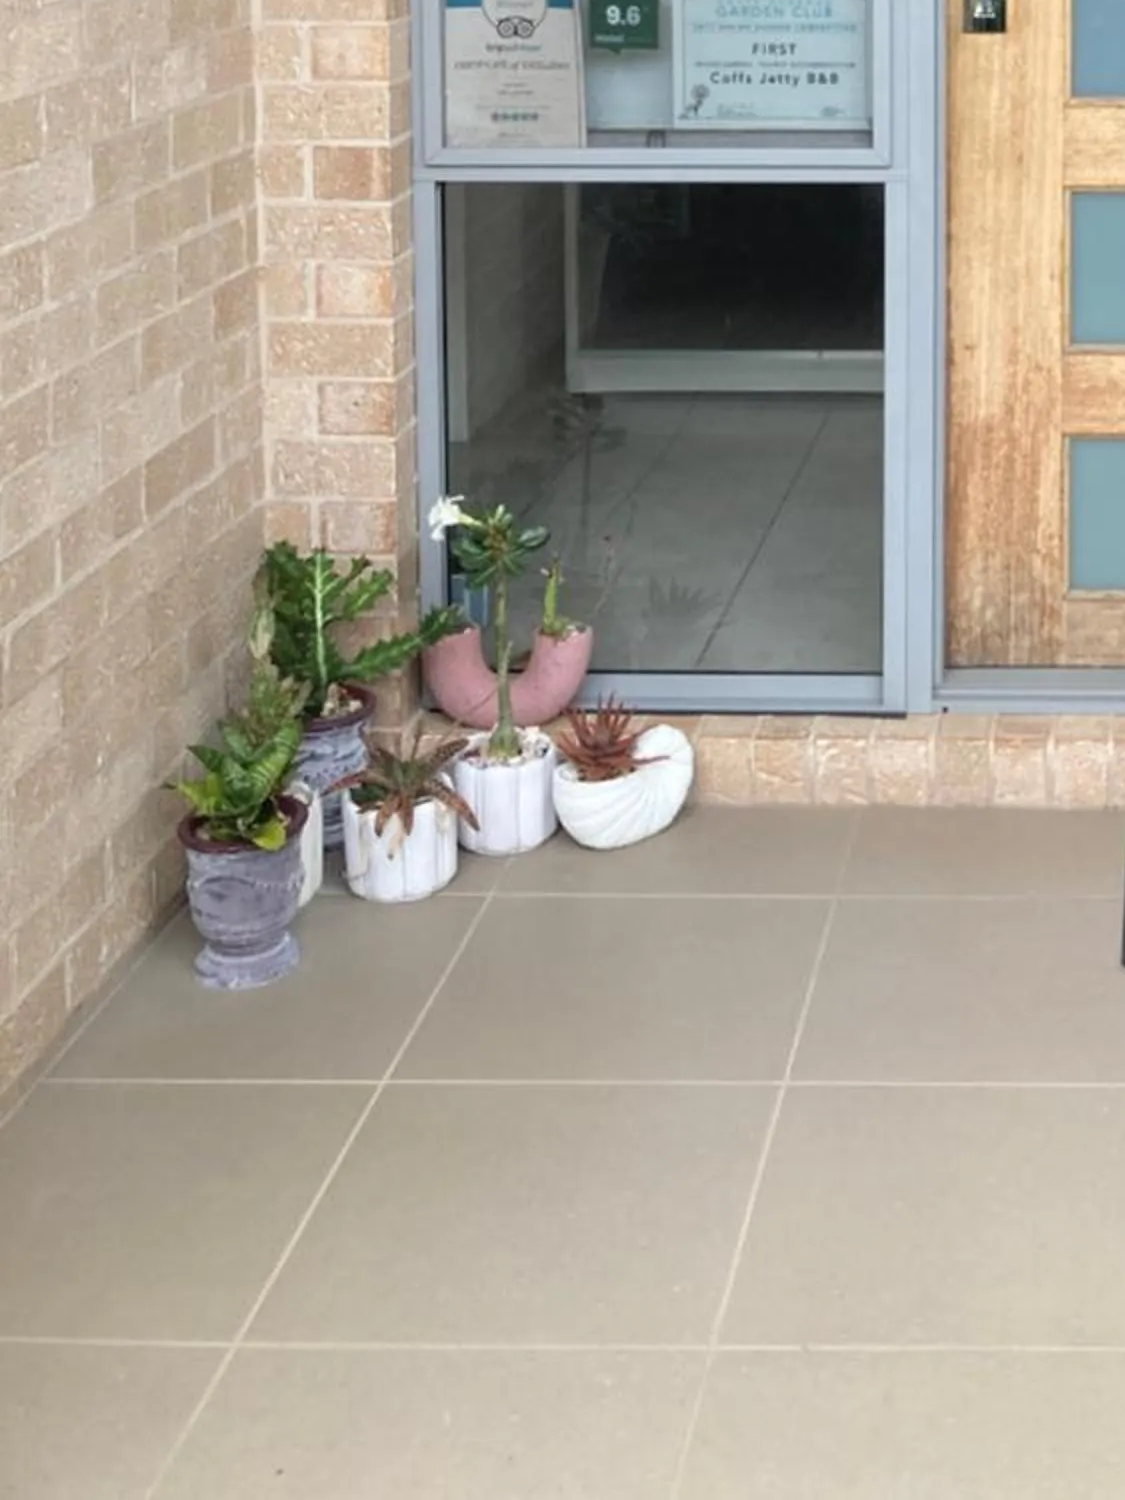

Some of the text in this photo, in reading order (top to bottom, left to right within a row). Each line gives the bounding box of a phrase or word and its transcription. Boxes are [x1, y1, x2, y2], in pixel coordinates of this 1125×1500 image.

[605, 4, 641, 26] 9.6
[751, 43, 797, 55] FIRST
[709, 72, 839, 87] Coffs Jetty B&B
